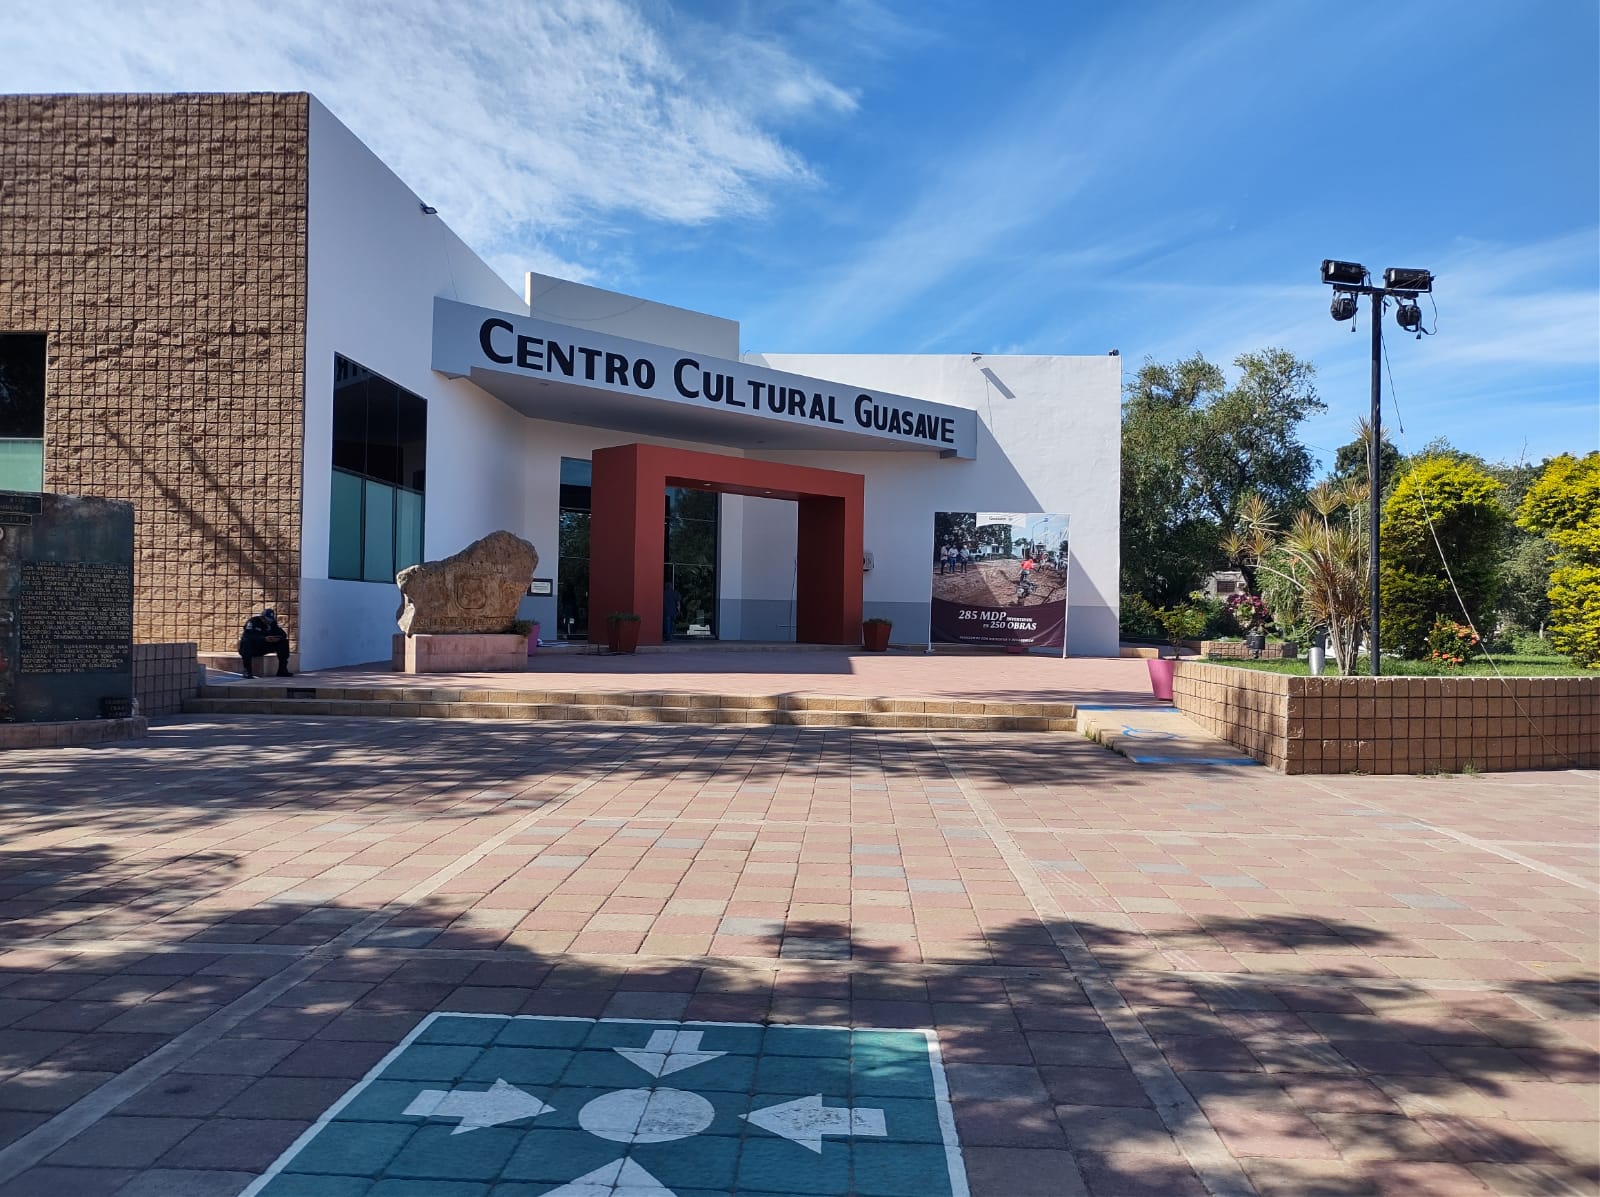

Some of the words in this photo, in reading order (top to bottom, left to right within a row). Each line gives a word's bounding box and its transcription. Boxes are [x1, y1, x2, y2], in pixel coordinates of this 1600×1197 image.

[479, 317, 656, 389] CENTRO
[673, 358, 844, 425] CULTURAL
[854, 394, 955, 444] GUASAVE
[958, 610, 978, 620] 285
[979, 611, 1007, 621] MDP
[990, 621, 1006, 629] 250
[1007, 622, 1037, 630] OBRAS
